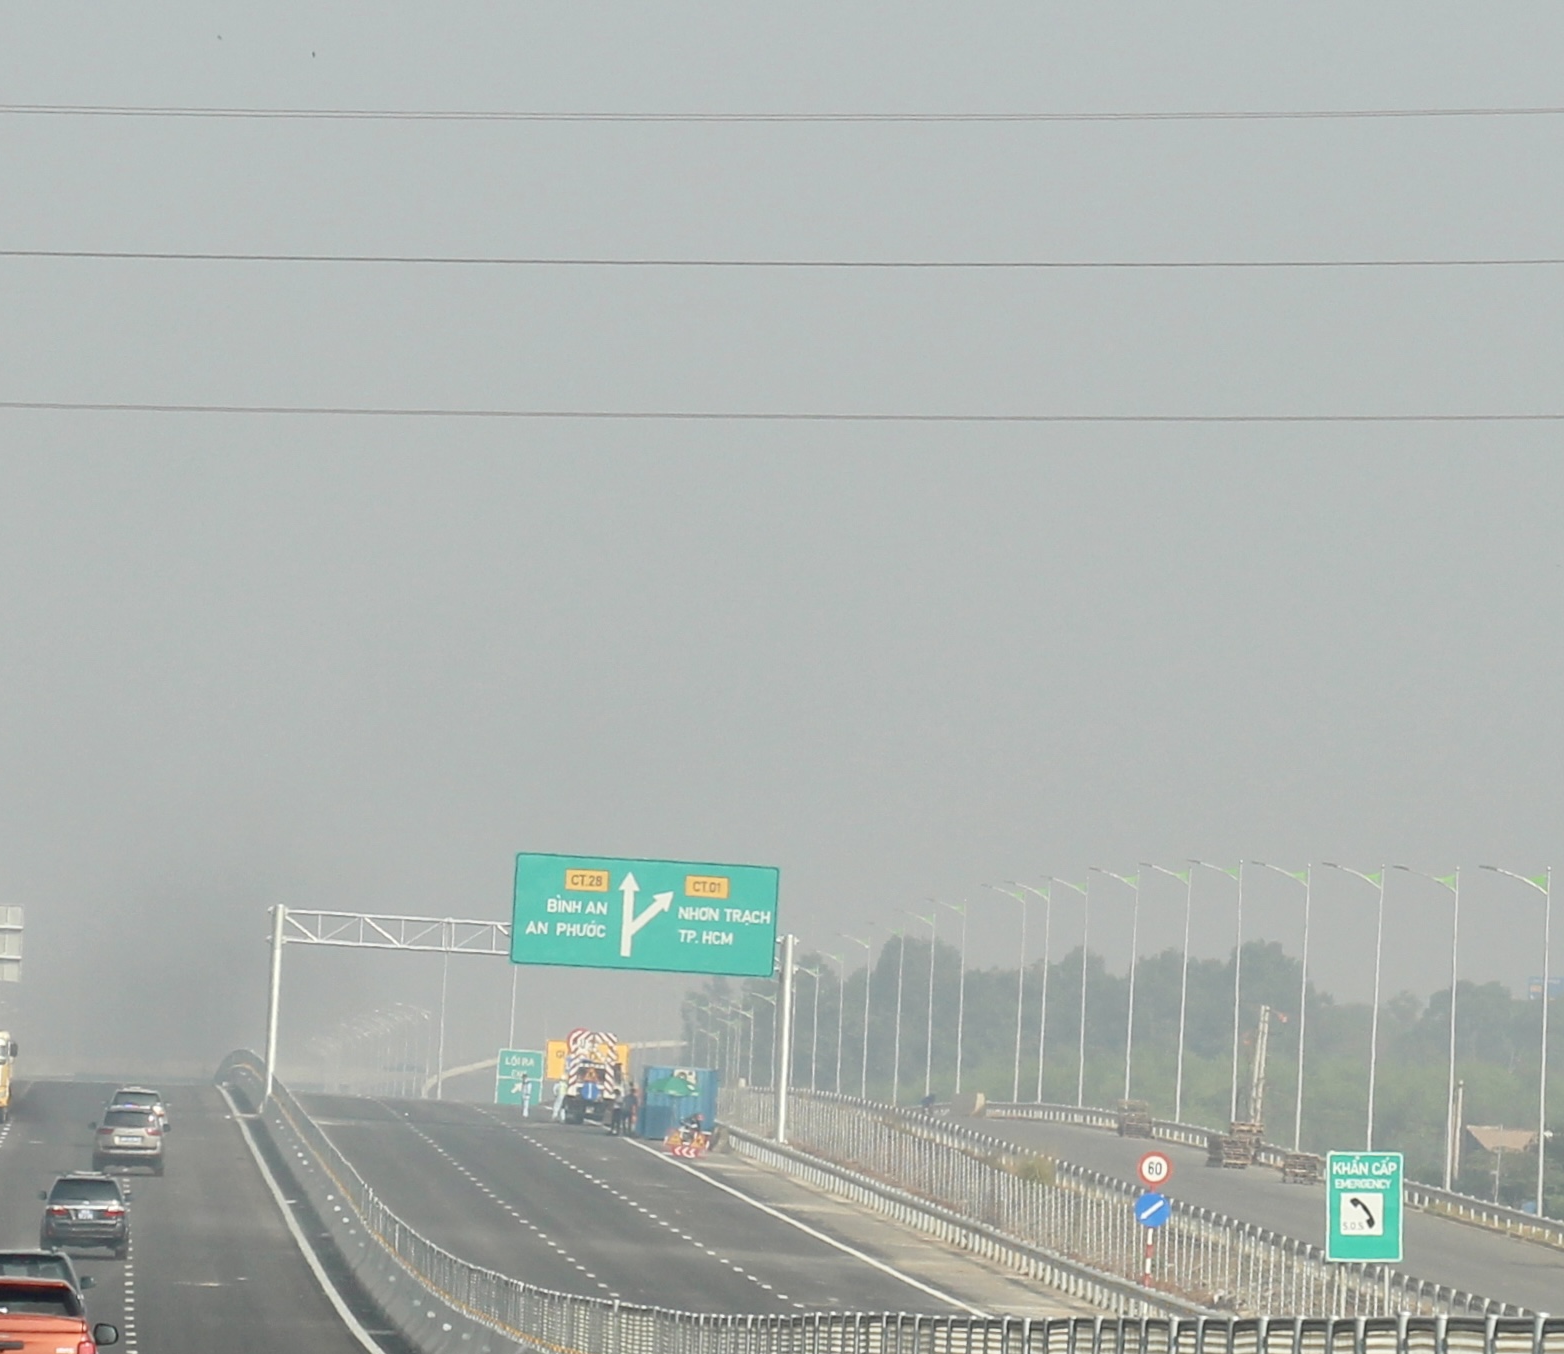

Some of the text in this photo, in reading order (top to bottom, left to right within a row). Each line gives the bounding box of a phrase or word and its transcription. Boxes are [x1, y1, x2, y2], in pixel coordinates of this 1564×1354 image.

[571, 874, 603, 887] CT.28
[692, 881, 721, 893] CT.01
[547, 894, 608, 915] BÌNH AN
[678, 906, 771, 926] NHƠN TRẠCH
[525, 920, 606, 938] AN PHƯỚC
[678, 929, 733, 945] TP. HCM
[1147, 1161, 1163, 1177] 60
[1371, 1156, 1397, 1175] CẤP
[1335, 1178, 1392, 1189] EMERGENCY
